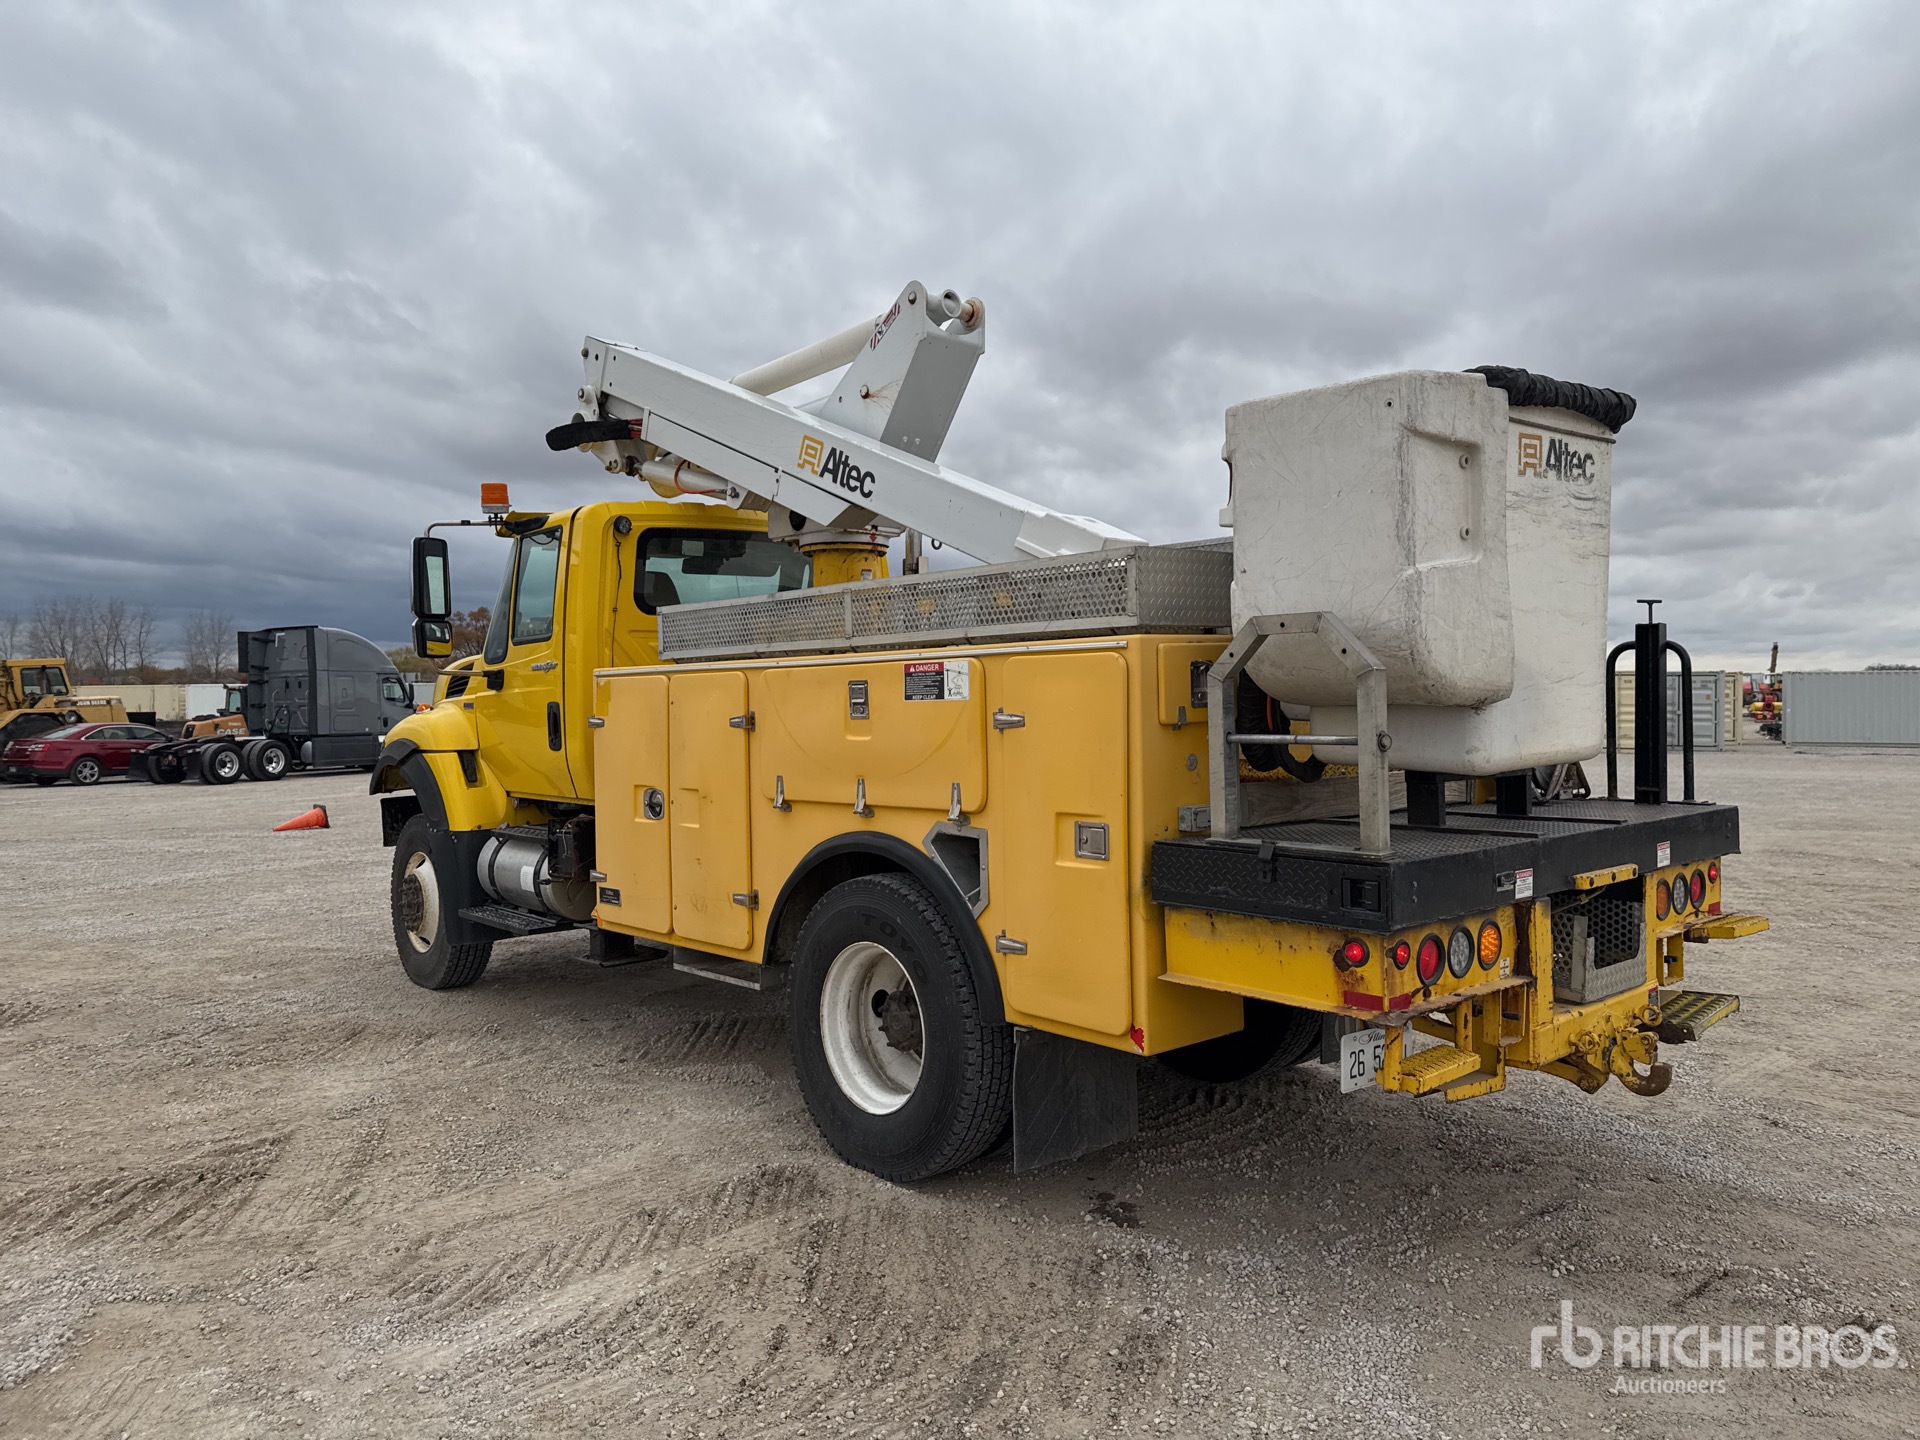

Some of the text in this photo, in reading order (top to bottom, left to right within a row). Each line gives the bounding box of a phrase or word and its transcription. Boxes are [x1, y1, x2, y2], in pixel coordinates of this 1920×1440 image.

[819, 447, 876, 499] Altec
[1543, 437, 1595, 484] Altec
[915, 664, 940, 672] DANGER
[216, 727, 247, 736] CASE
[860, 912, 929, 985] TOYO
[1358, 1030, 1385, 1046] Illin
[1349, 1048, 1366, 1080] 26
